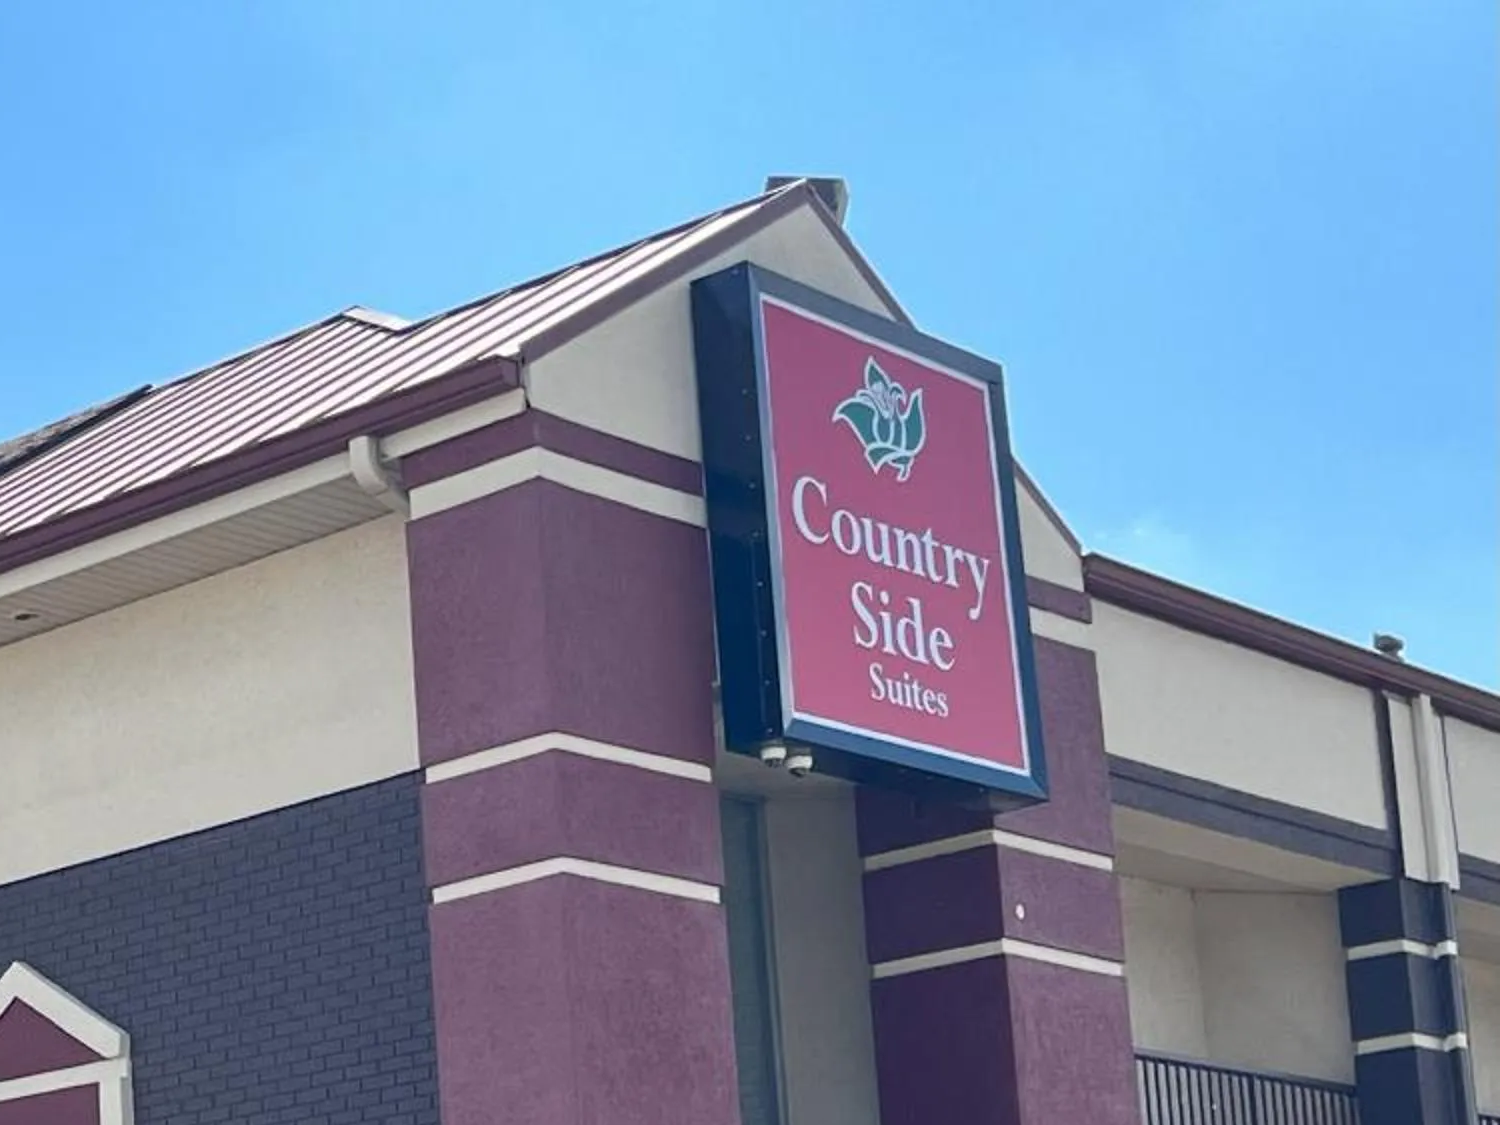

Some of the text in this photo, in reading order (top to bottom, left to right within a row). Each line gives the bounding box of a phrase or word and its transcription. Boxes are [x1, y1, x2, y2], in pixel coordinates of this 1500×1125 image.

[791, 476, 990, 621] Country
[850, 580, 956, 672] Side
[869, 662, 949, 718] Suites
